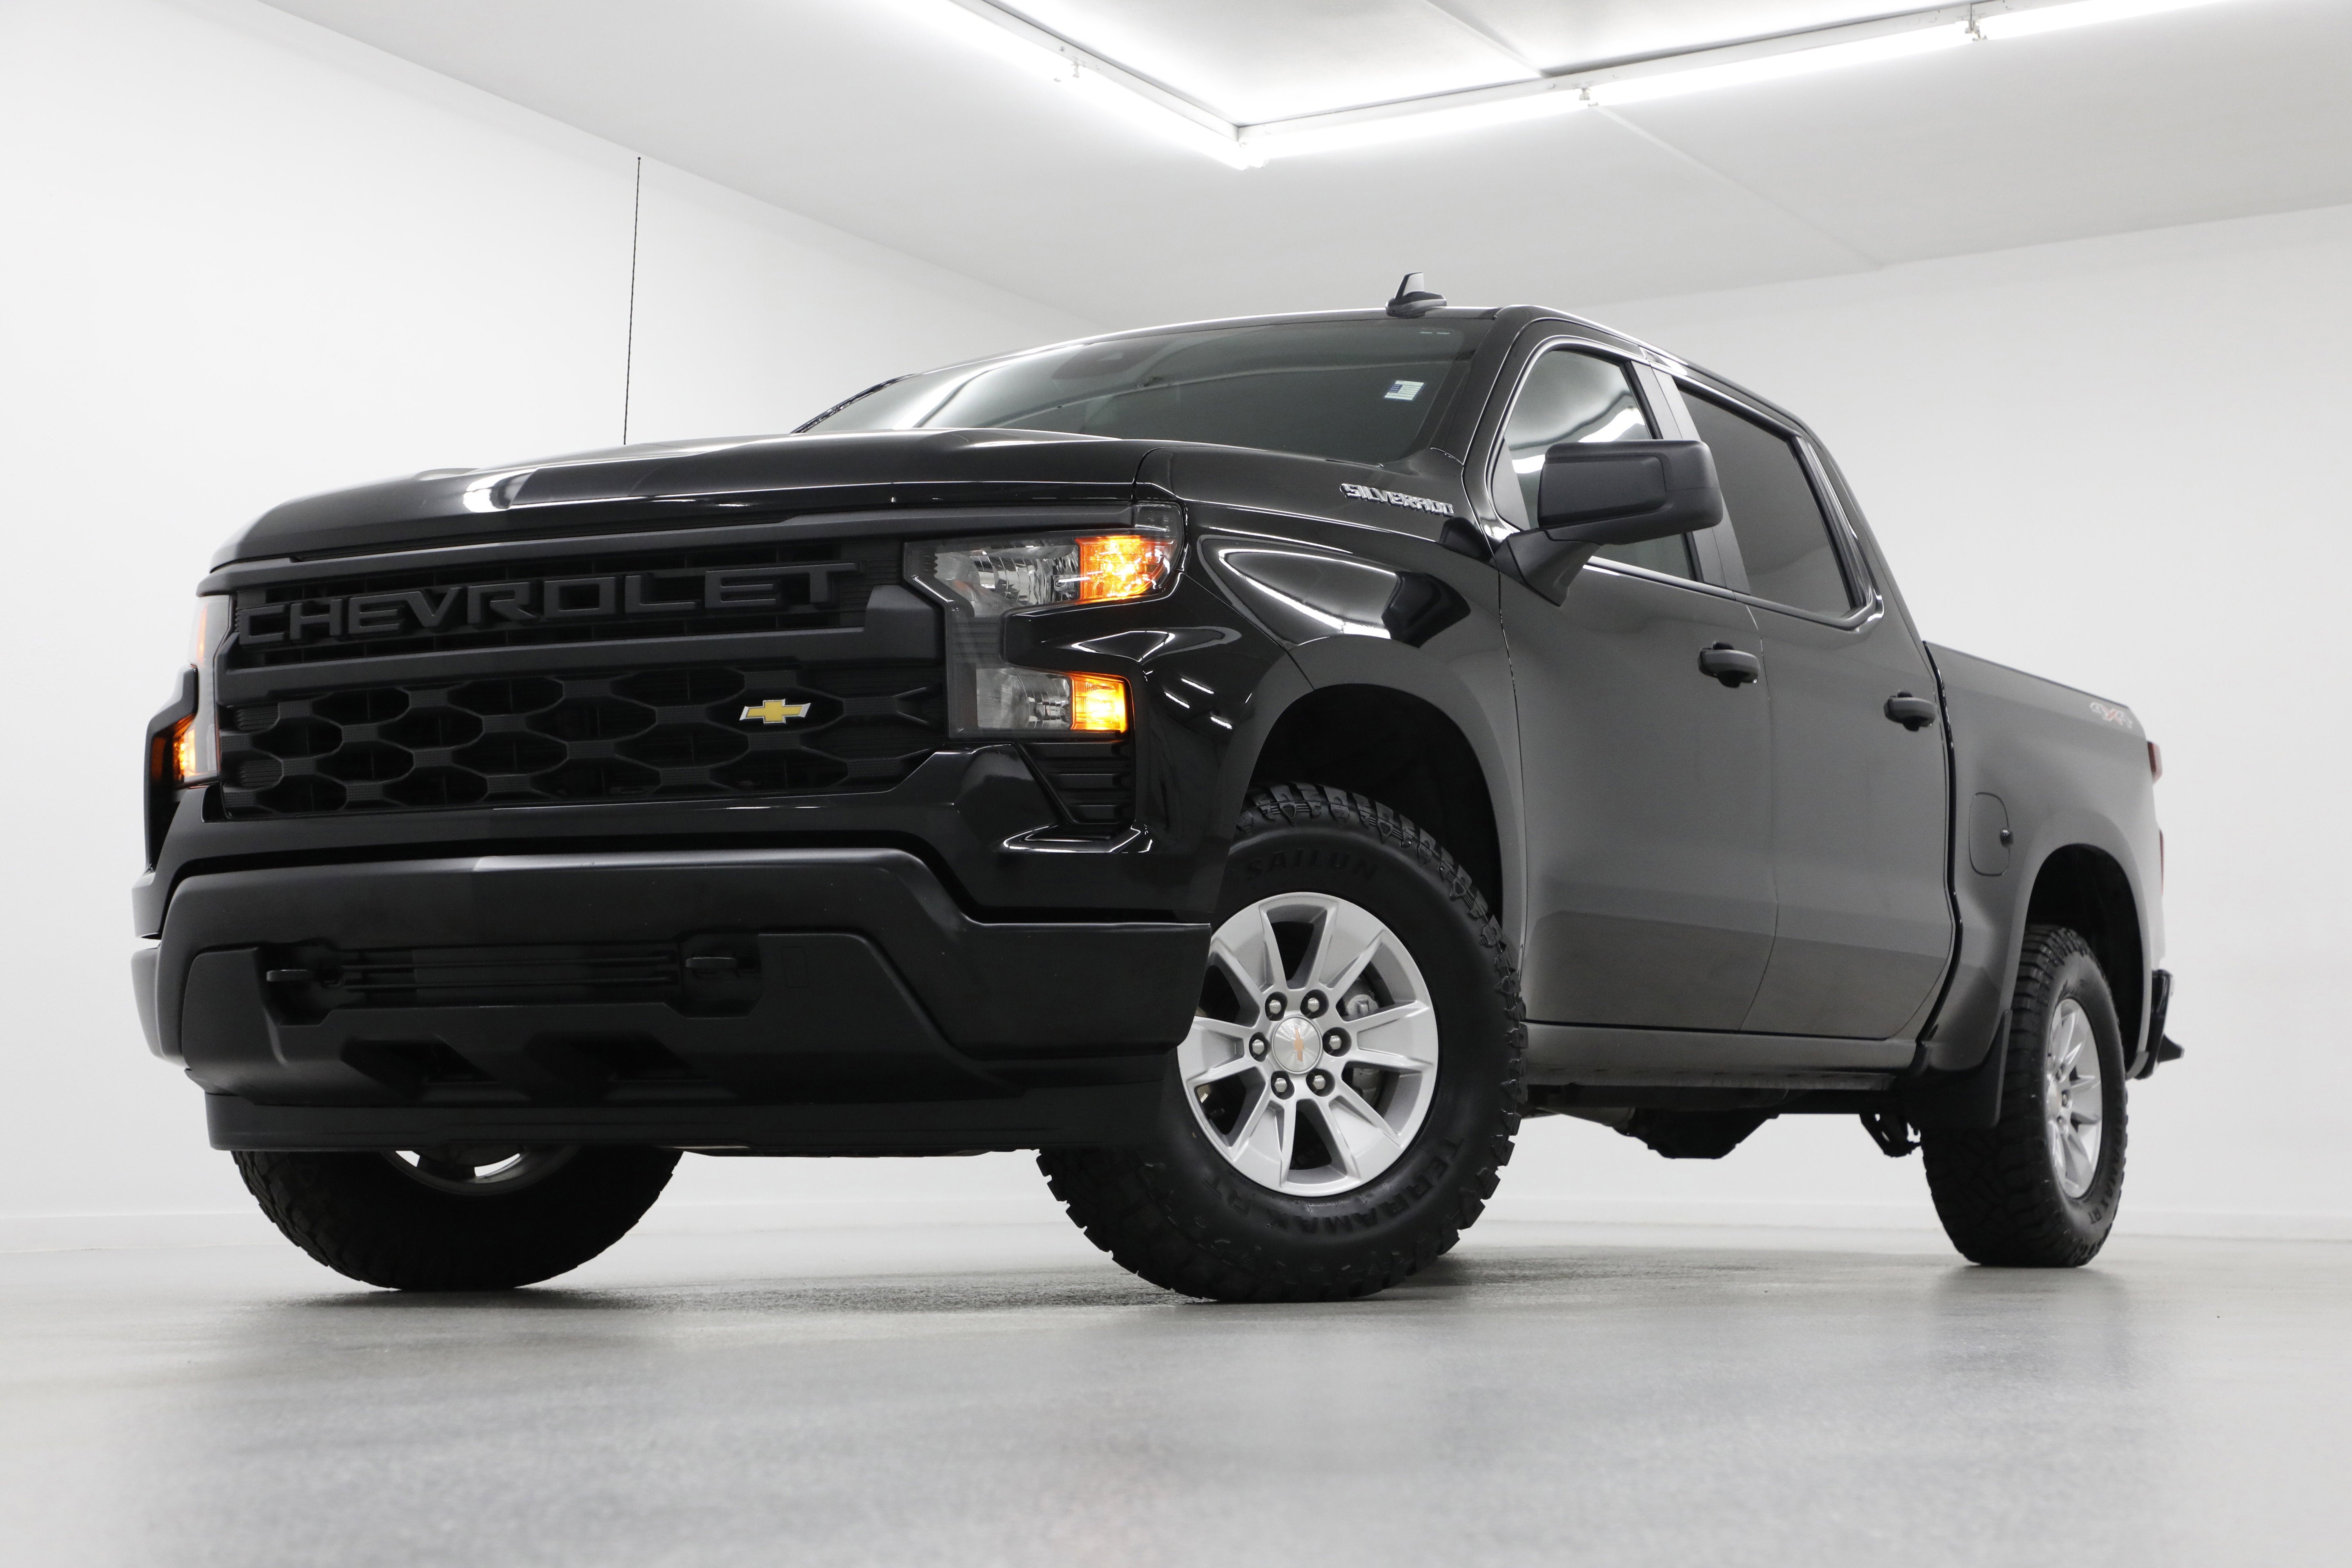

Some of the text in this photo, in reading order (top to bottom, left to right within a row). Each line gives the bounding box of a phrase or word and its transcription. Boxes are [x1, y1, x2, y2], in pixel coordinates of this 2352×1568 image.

[1340, 483, 1455, 517] SILVERADO
[238, 561, 863, 646] CHEVROLET
[1246, 848, 1378, 881] SAILUN
[1266, 1137, 1465, 1234] TERRAMAX
